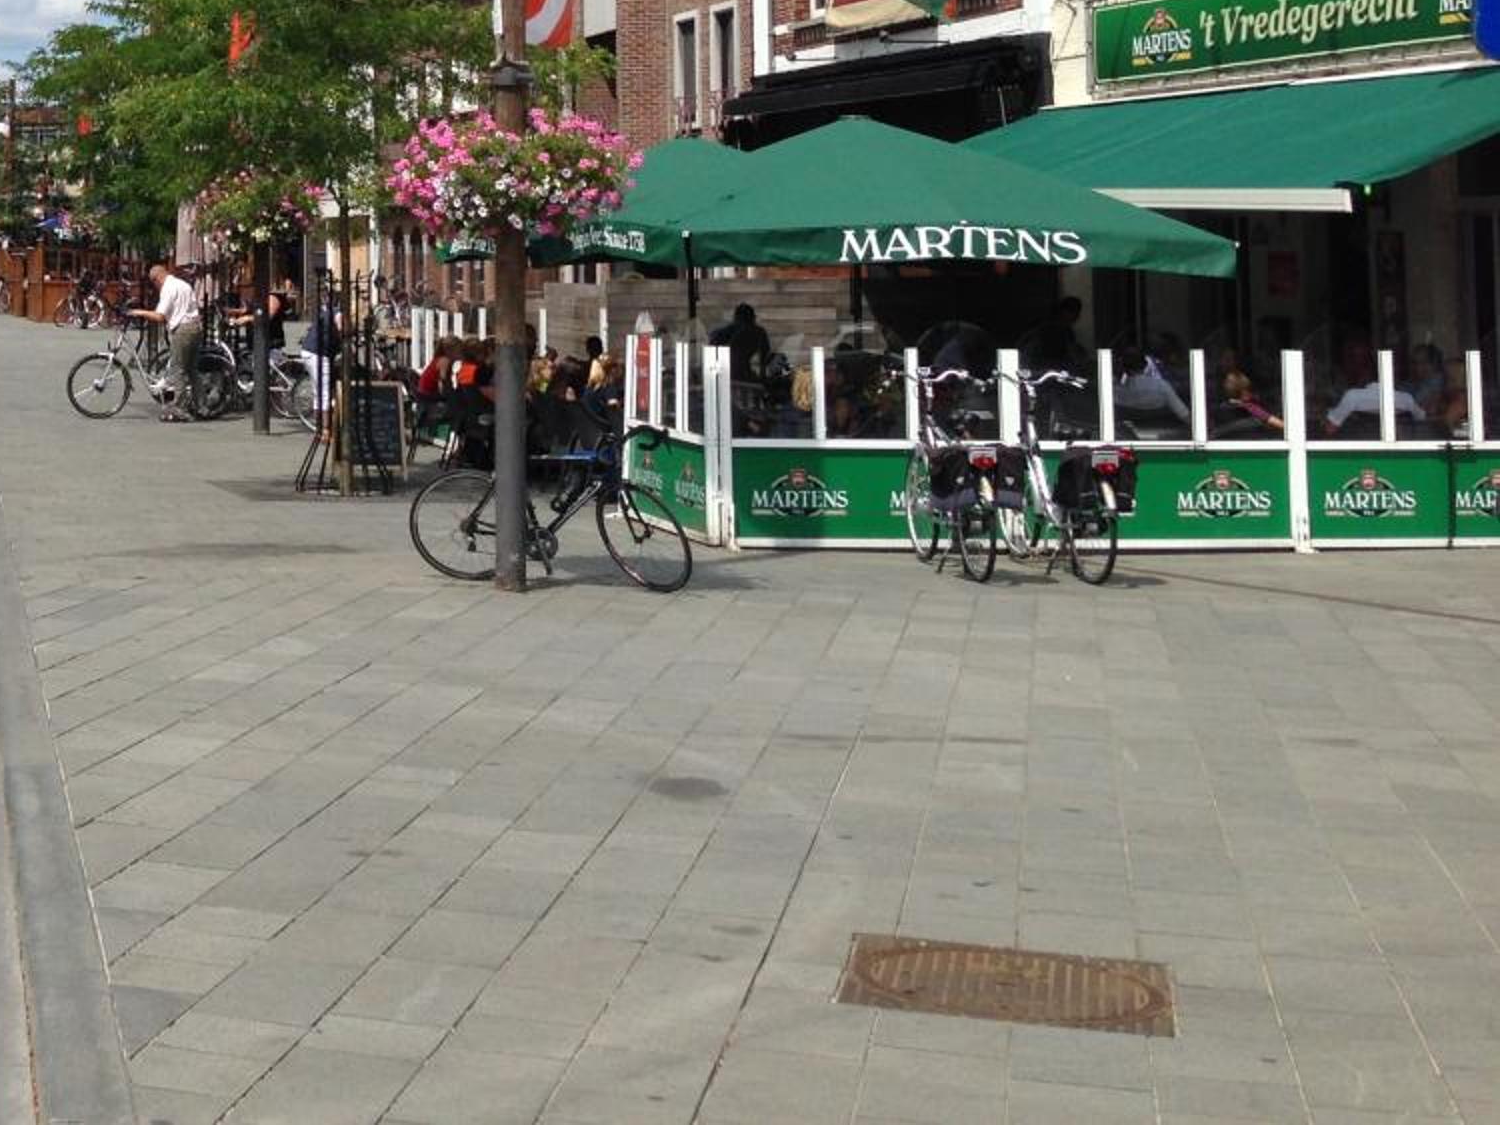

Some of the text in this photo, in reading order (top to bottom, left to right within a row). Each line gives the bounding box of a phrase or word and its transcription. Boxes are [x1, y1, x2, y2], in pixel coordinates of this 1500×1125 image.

[1132, 28, 1192, 56] MARTENS
[839, 220, 1088, 264] MARTENS
[751, 489, 849, 508] MARTENS
[1177, 491, 1271, 509] MARTENS
[1324, 491, 1417, 509] MARTENS
